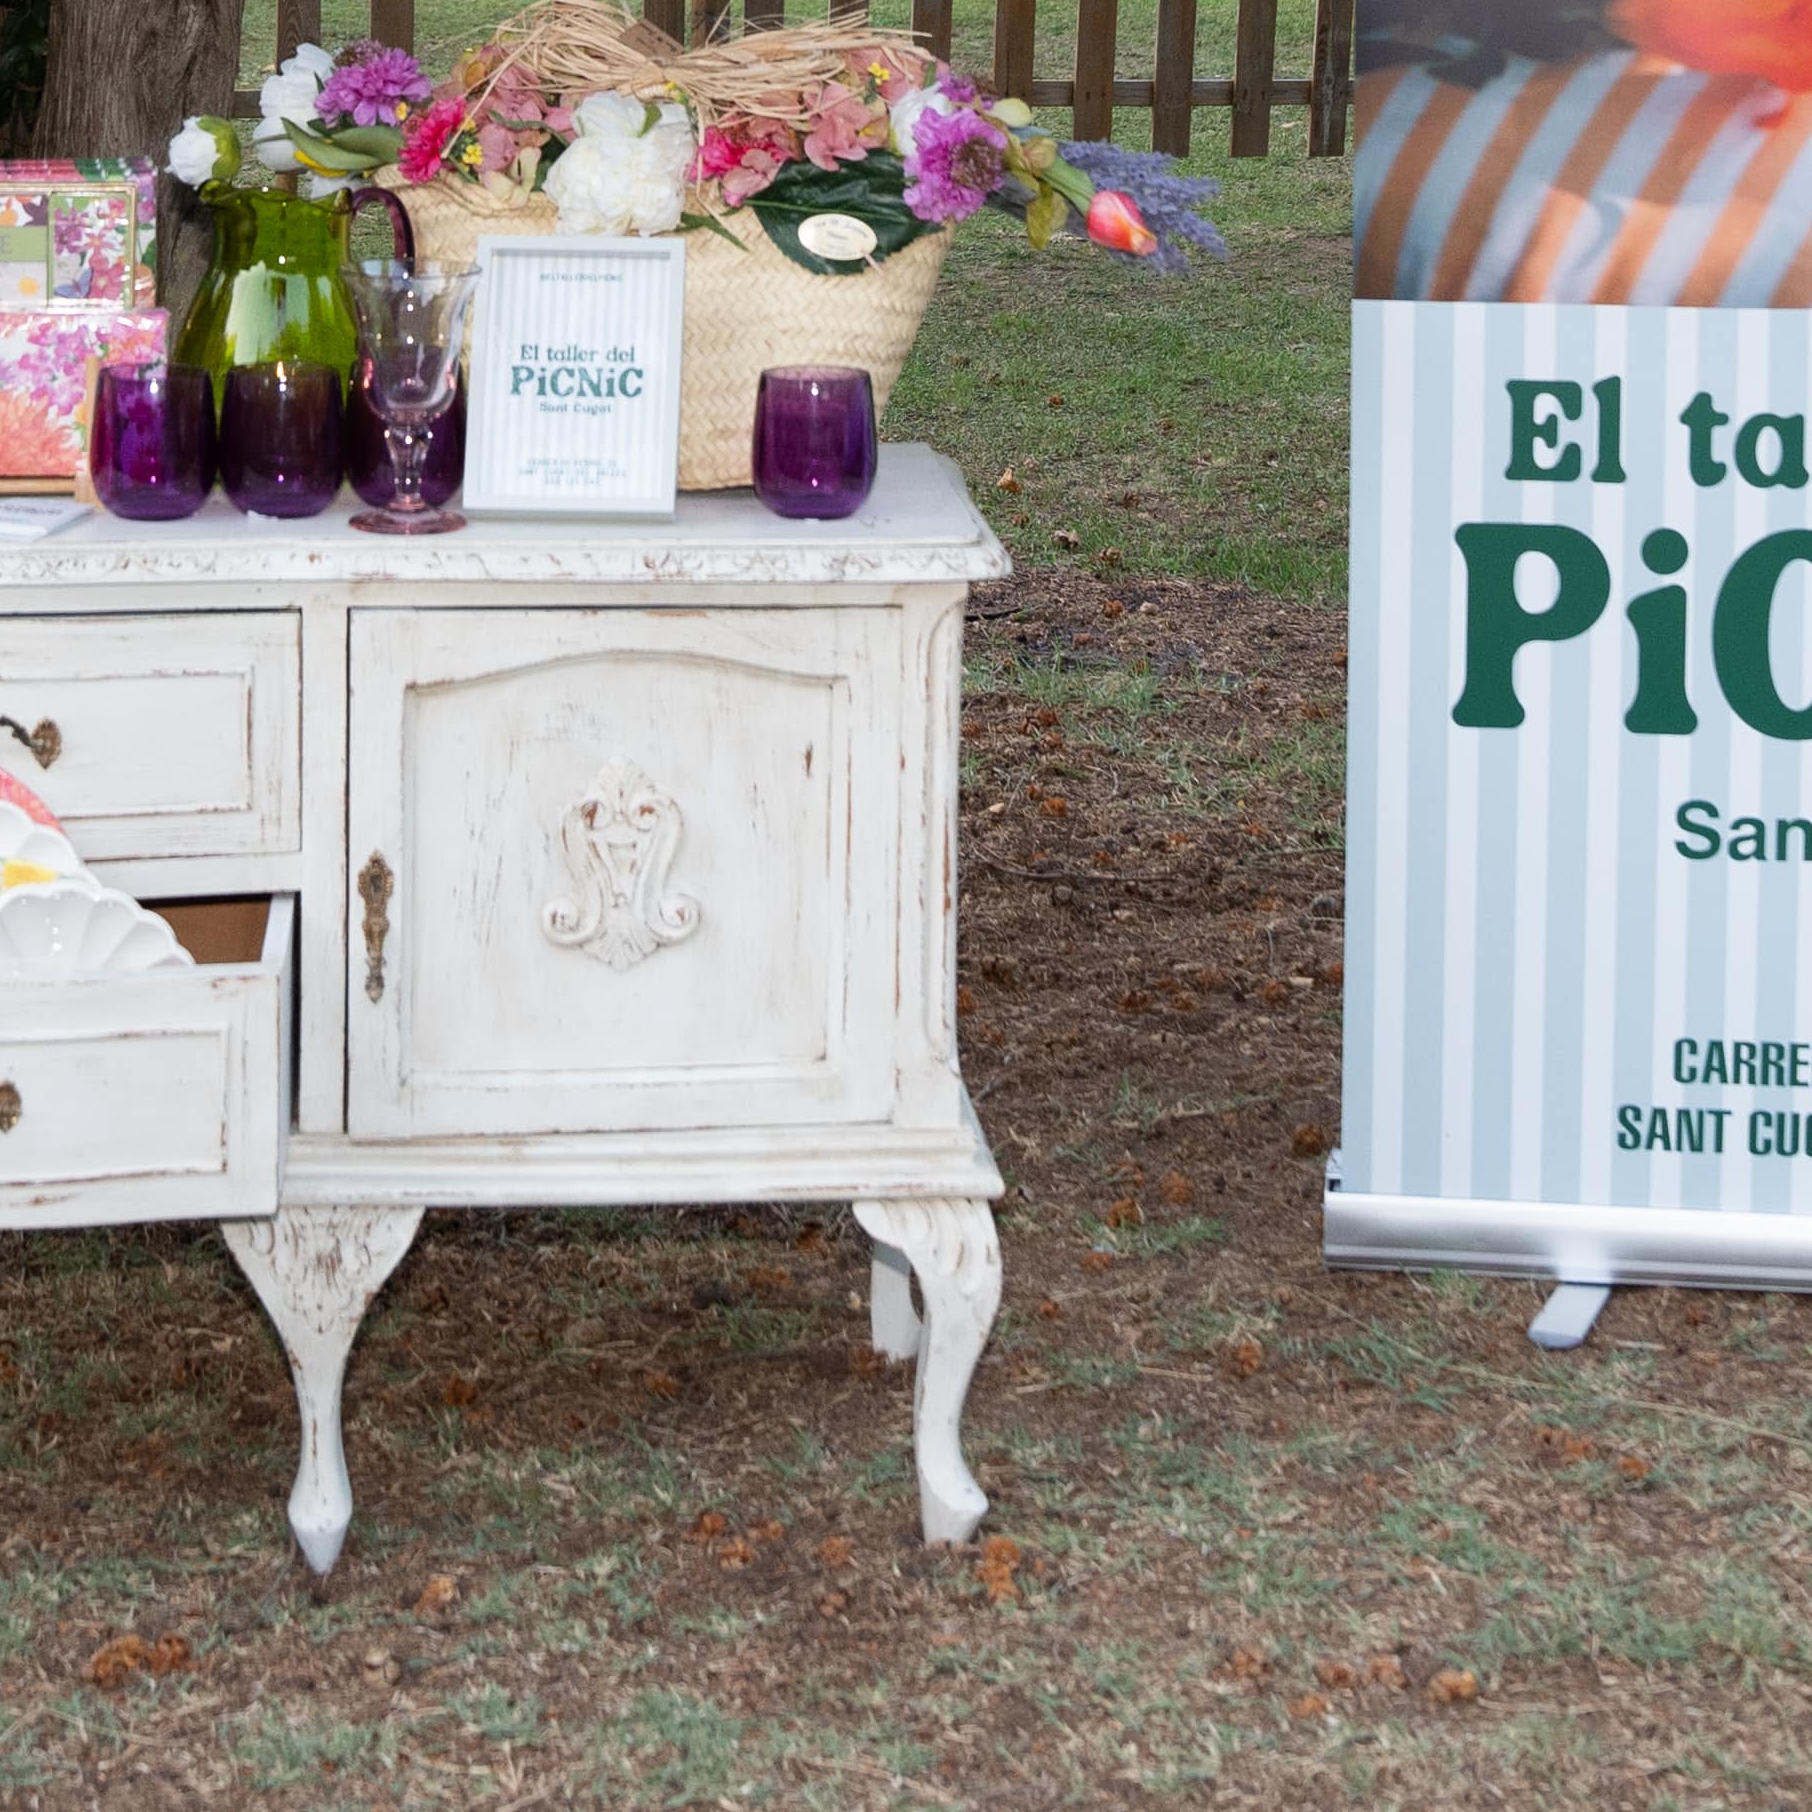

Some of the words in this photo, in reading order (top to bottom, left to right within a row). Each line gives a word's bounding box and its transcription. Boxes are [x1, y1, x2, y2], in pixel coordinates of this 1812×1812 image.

[520, 343, 540, 362] El
[546, 344, 598, 363] taller
[605, 345, 636, 363] del
[509, 364, 645, 399] PiCNiC
[1504, 375, 1627, 484] El
[1616, 1104, 1734, 1155] SANT
